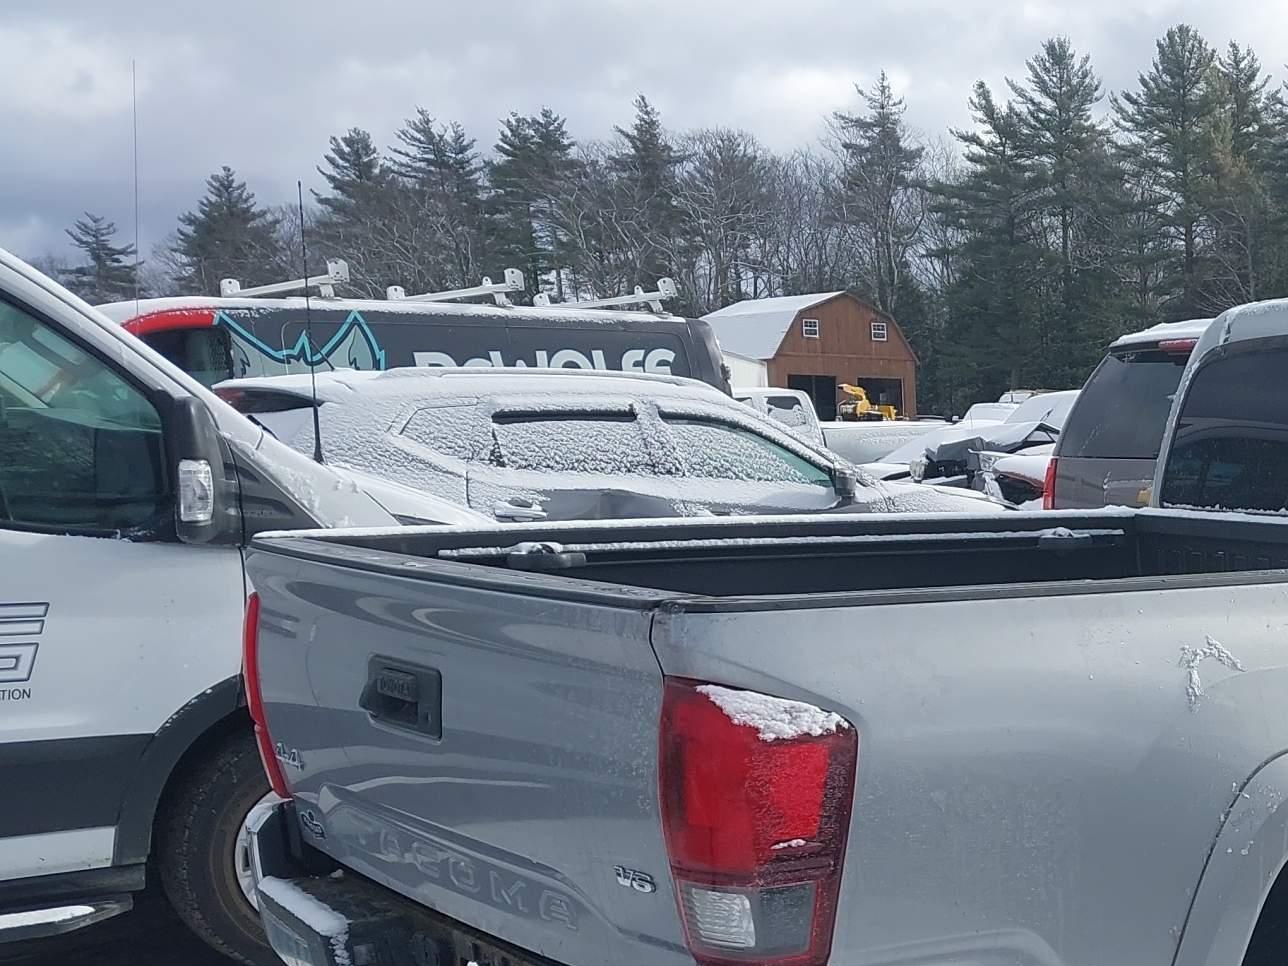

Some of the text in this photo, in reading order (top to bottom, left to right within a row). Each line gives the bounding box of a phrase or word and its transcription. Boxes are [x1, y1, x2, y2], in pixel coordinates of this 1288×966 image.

[0, 688, 31, 700] TION
[352, 824, 579, 931] ACOMA
[613, 864, 657, 893] V6
